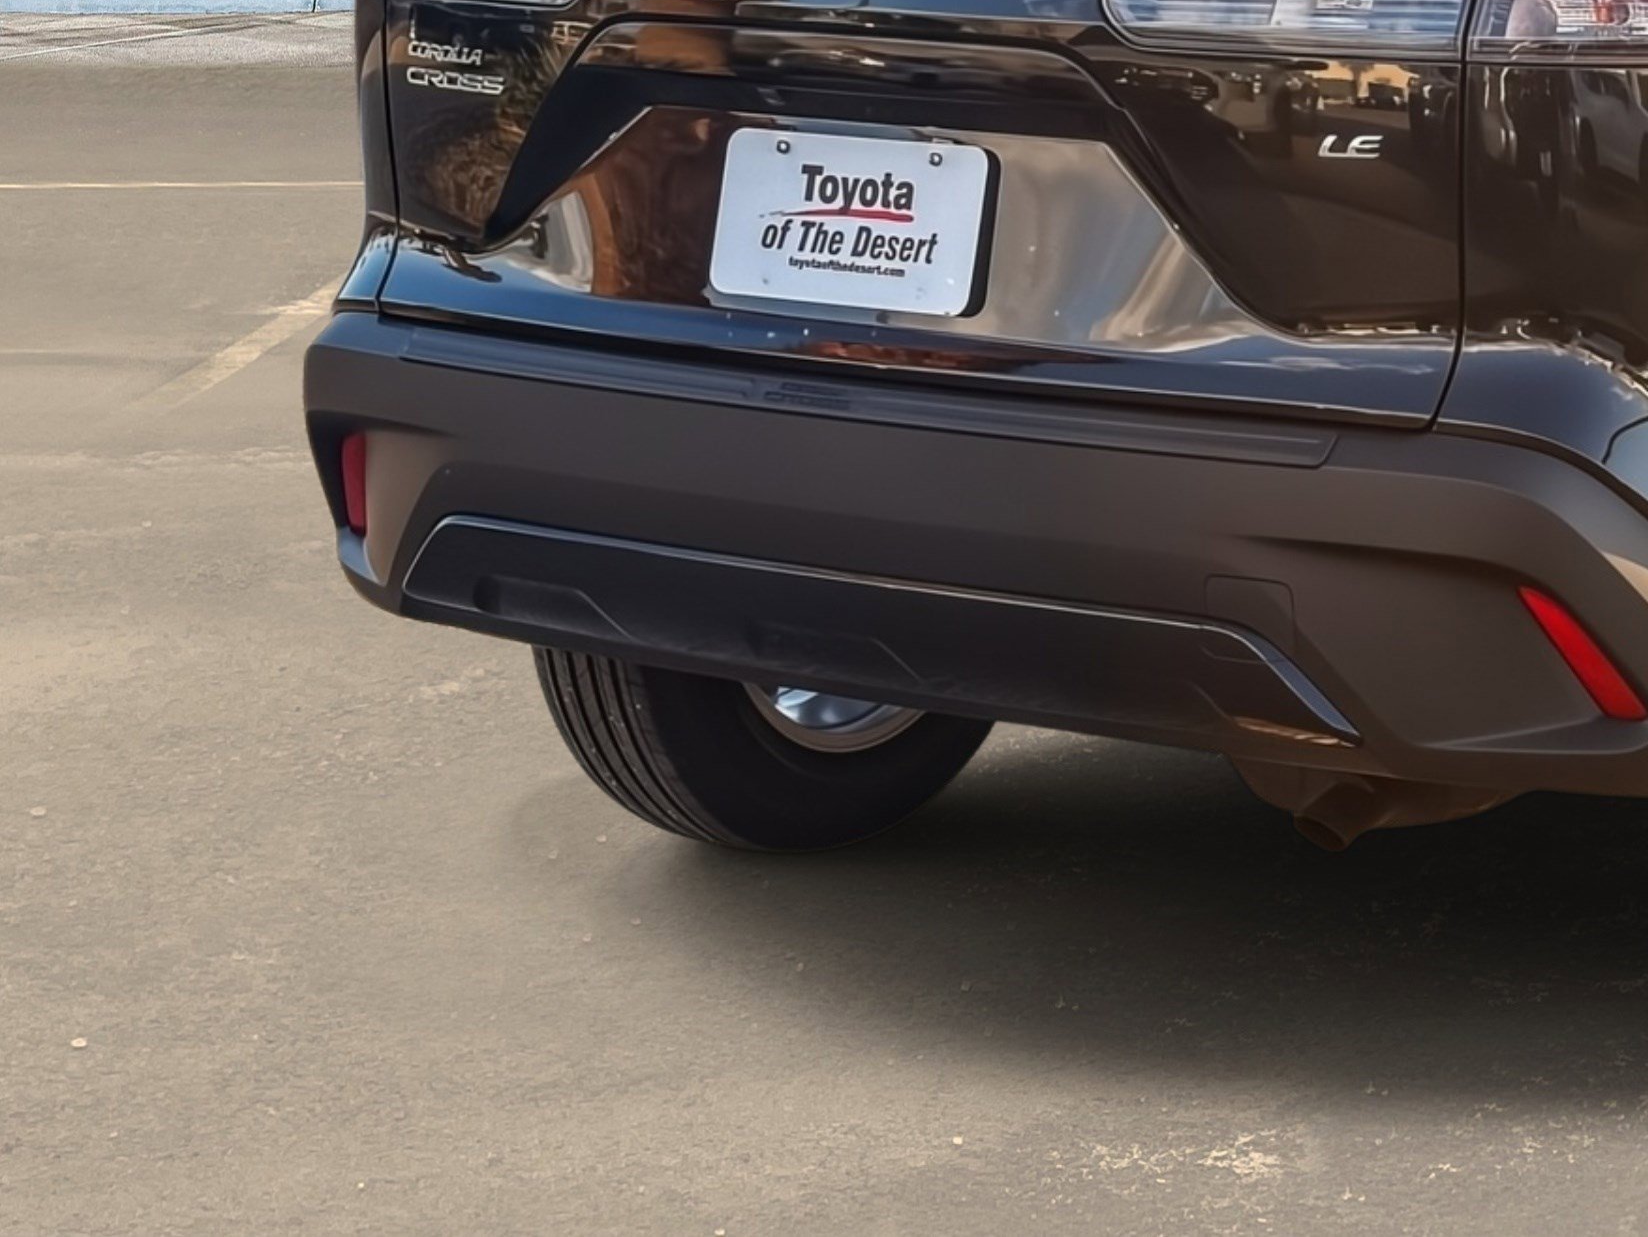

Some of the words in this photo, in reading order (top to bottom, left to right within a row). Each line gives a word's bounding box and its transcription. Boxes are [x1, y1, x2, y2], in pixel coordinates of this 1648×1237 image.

[406, 67, 504, 95] CROSS
[1318, 134, 1384, 159] LE
[801, 164, 914, 212] Toyota
[761, 219, 793, 250] of
[797, 220, 844, 255] The
[850, 225, 938, 264] Desert
[788, 255, 905, 277] toyotaofthedesert.com
